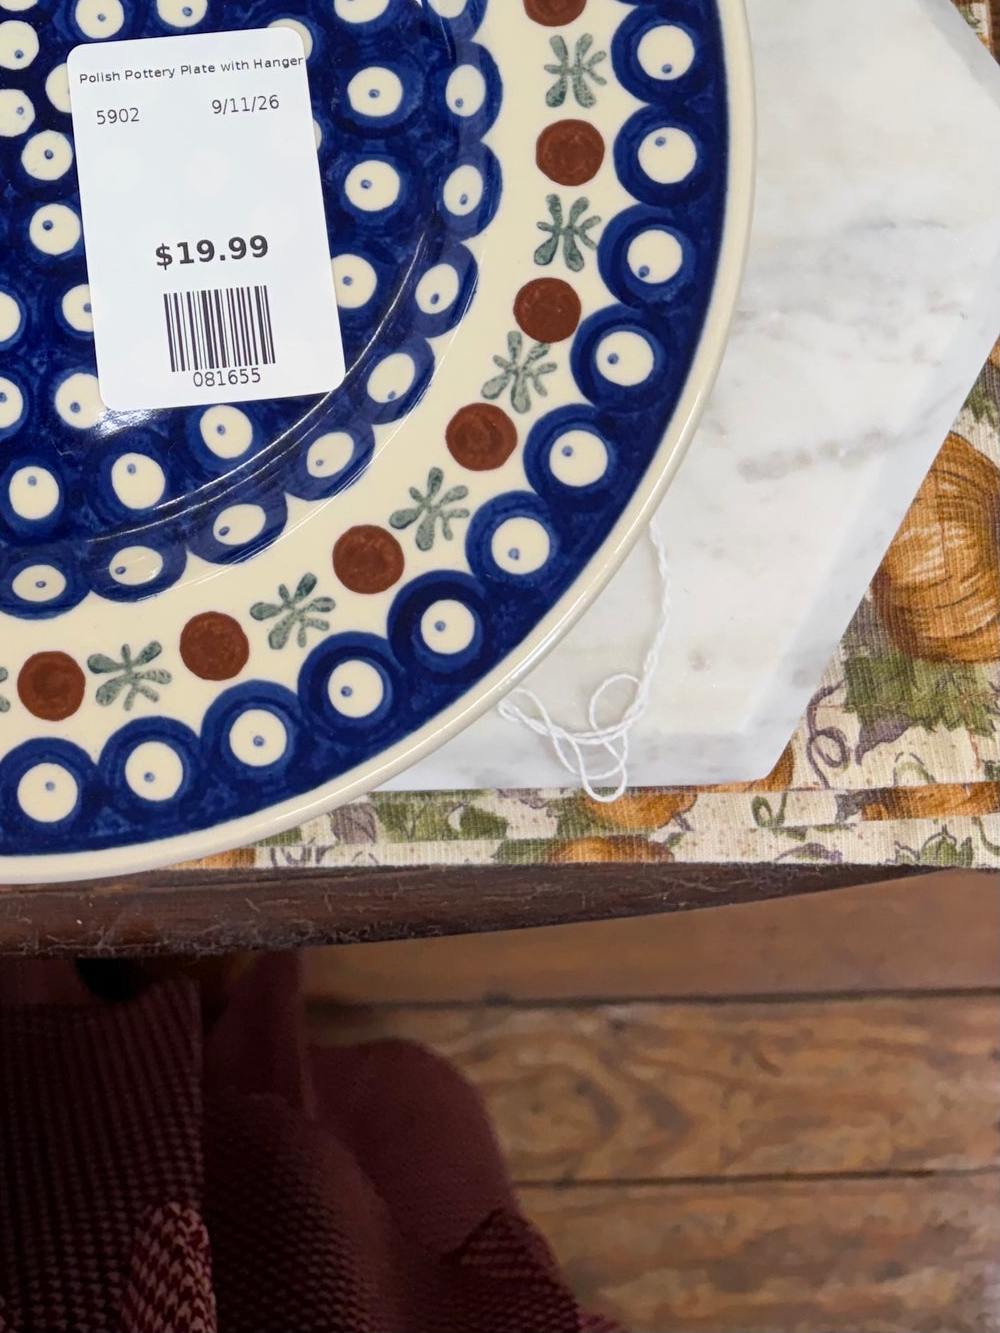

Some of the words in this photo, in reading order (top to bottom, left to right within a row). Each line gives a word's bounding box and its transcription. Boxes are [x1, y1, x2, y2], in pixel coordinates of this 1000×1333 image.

[79, 71, 120, 83] Polish
[125, 66, 176, 80] Pottery
[181, 63, 215, 75] Plate
[221, 59, 249, 71] with
[254, 55, 303, 70] Hanger
[212, 95, 280, 115] 9/11/26
[96, 107, 140, 125] 5902
[155, 235, 269, 270] $19.99
[193, 368, 261, 387] 081655
